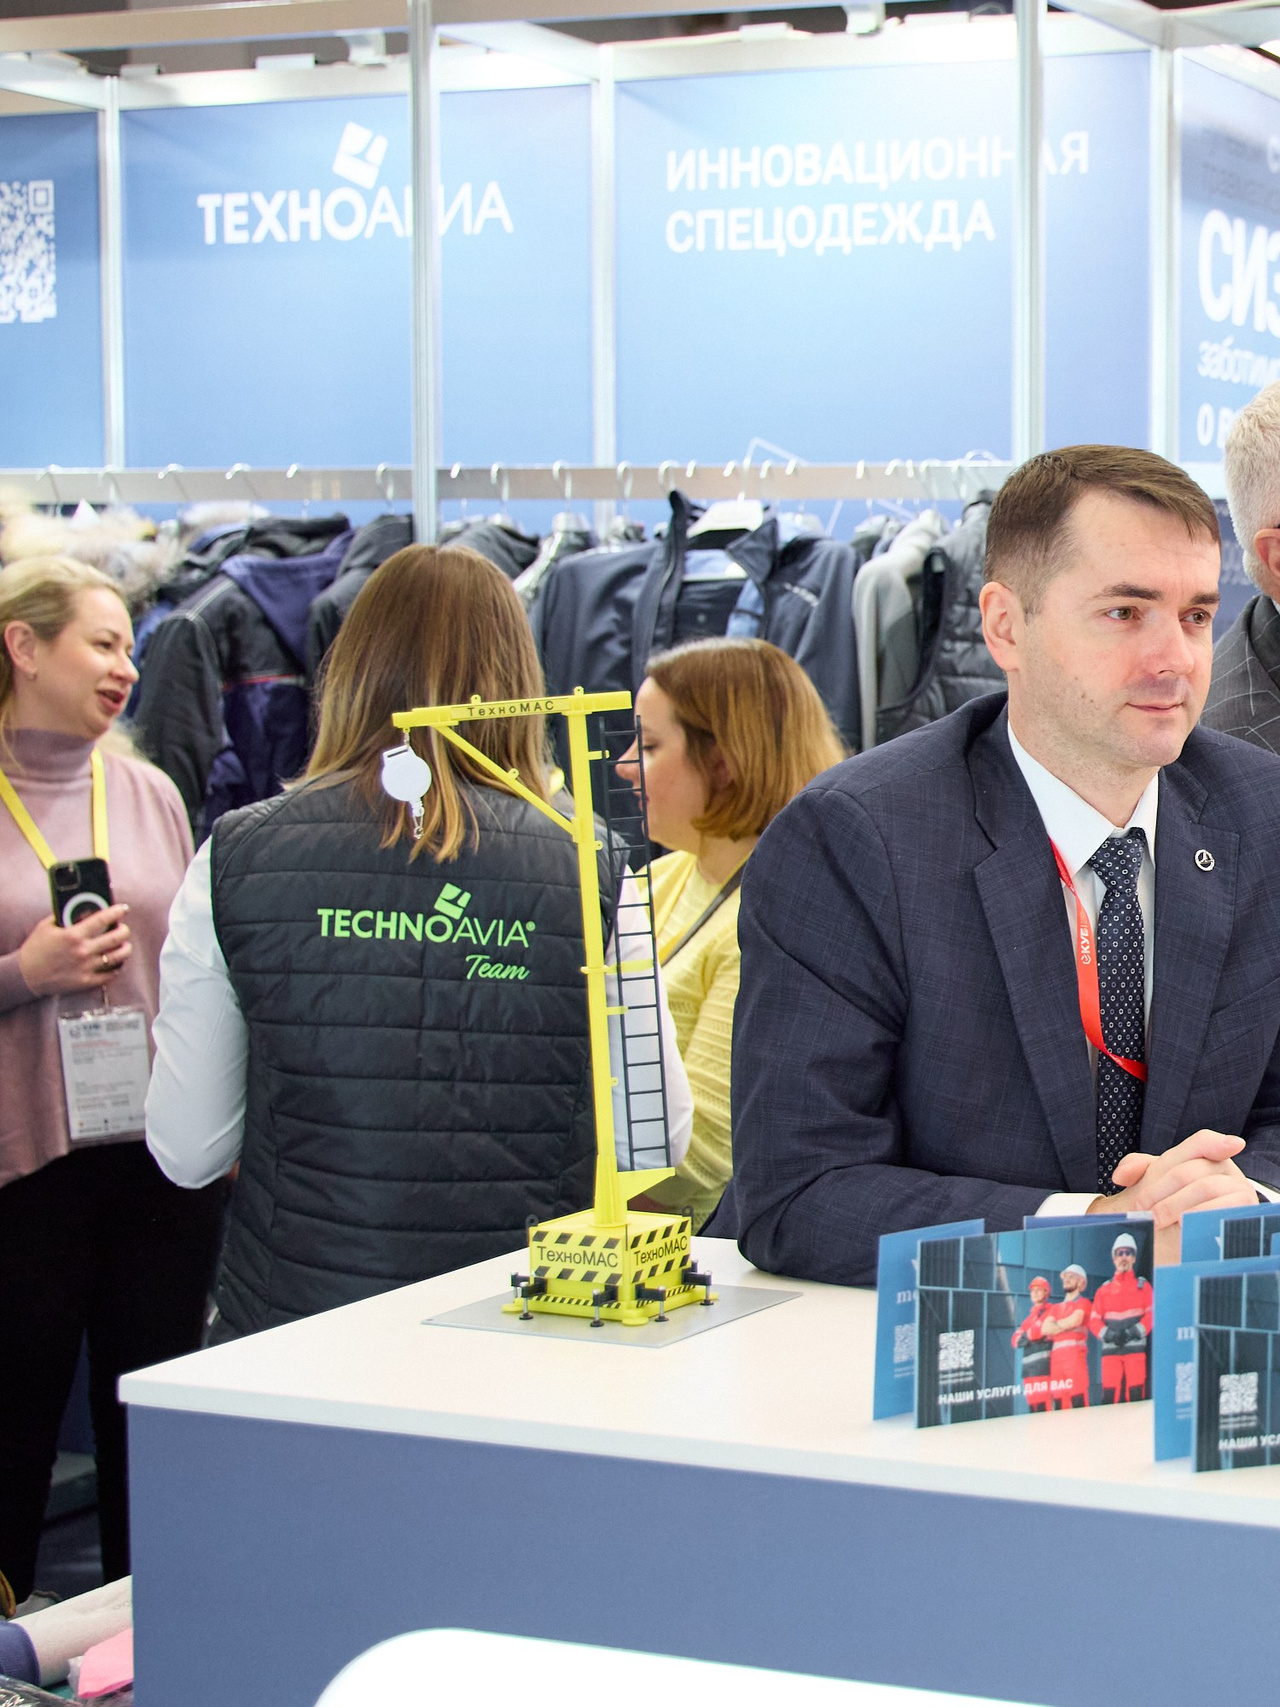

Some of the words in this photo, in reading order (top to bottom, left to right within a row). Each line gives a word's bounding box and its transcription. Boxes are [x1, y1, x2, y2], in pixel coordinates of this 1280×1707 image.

[665, 198, 997, 258] СПЕЦОДЕЖДА
[464, 953, 531, 981] Team
[536, 1245, 619, 1269] ТехноМАС
[633, 1234, 689, 1267] ТехноМАС
[938, 1390, 975, 1405] НАШИ
[976, 1384, 1022, 1400] УСЛУГИ
[1023, 1381, 1048, 1396] ДЛЯ
[1050, 1378, 1074, 1391] ВАС
[1218, 1436, 1258, 1451] НАШИ
